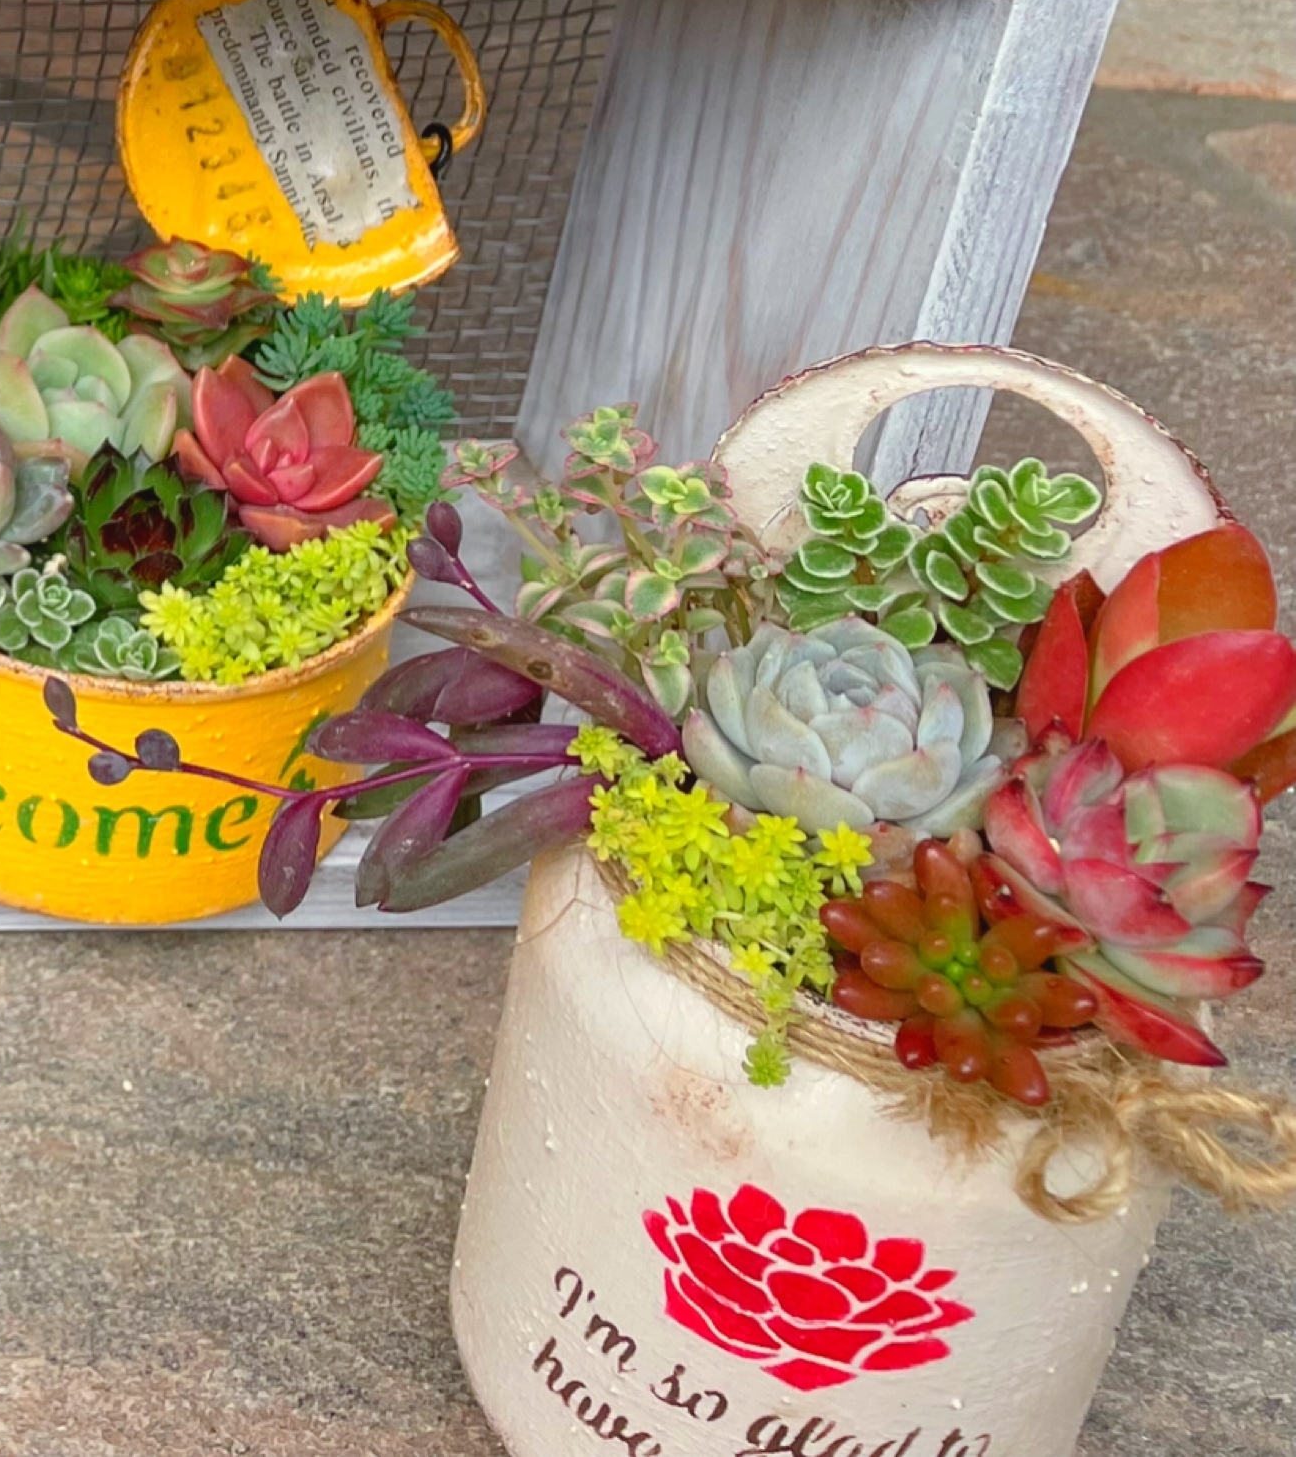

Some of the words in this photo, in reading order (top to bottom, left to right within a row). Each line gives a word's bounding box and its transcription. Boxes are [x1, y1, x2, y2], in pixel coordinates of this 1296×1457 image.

[203, 5, 279, 146] predominantly
[268, 147, 307, 211] Sunni
[249, 25, 274, 70] The
[268, 75, 302, 134] battle
[295, 141, 314, 163] in
[290, 56, 321, 103] said.
[345, 45, 406, 159] recovered
[554, 1265, 637, 1373] I'm
[650, 1363, 729, 1422] so
